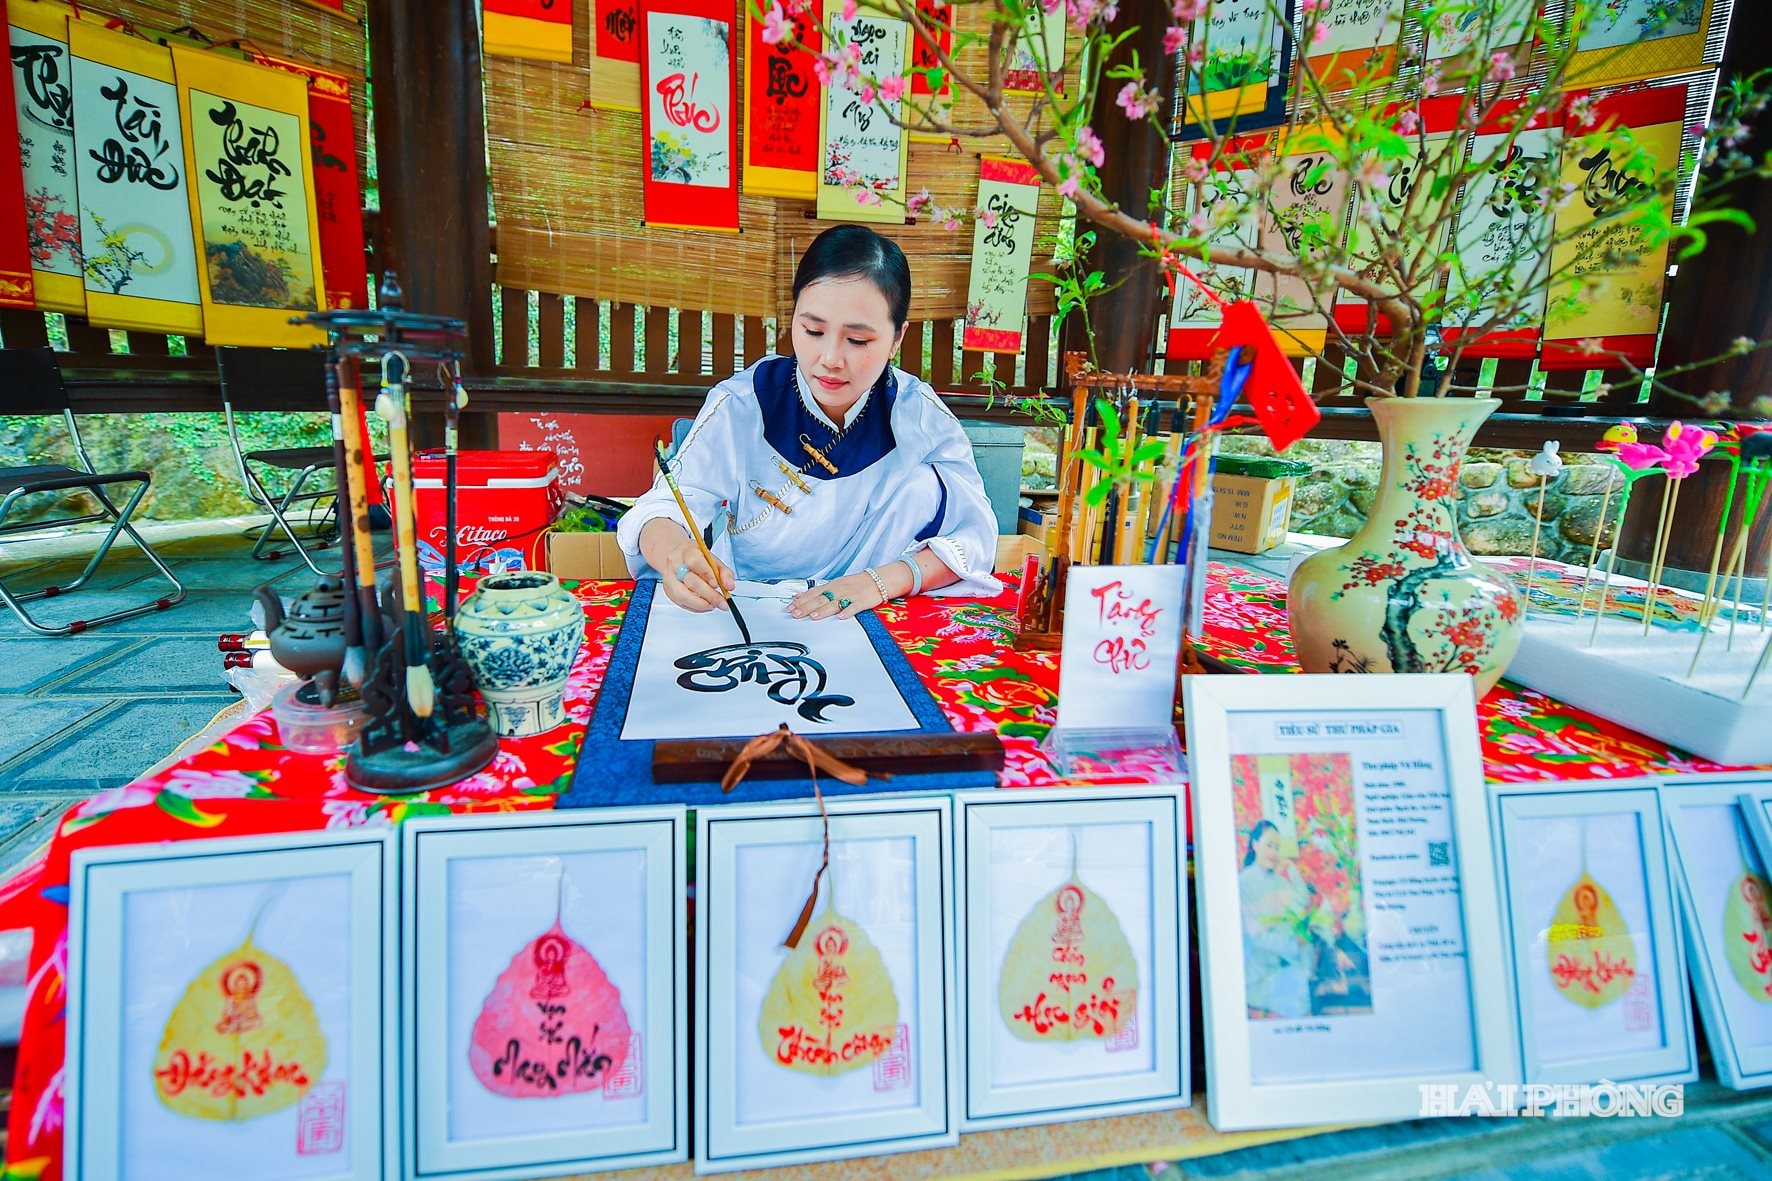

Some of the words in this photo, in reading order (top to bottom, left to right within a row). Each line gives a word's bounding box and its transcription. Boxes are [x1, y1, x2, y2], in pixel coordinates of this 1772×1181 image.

[100, 76, 162, 150] Tài
[656, 71, 720, 133] Phúc
[89, 138, 180, 190] Đức
[1091, 581, 1164, 630] Tặng
